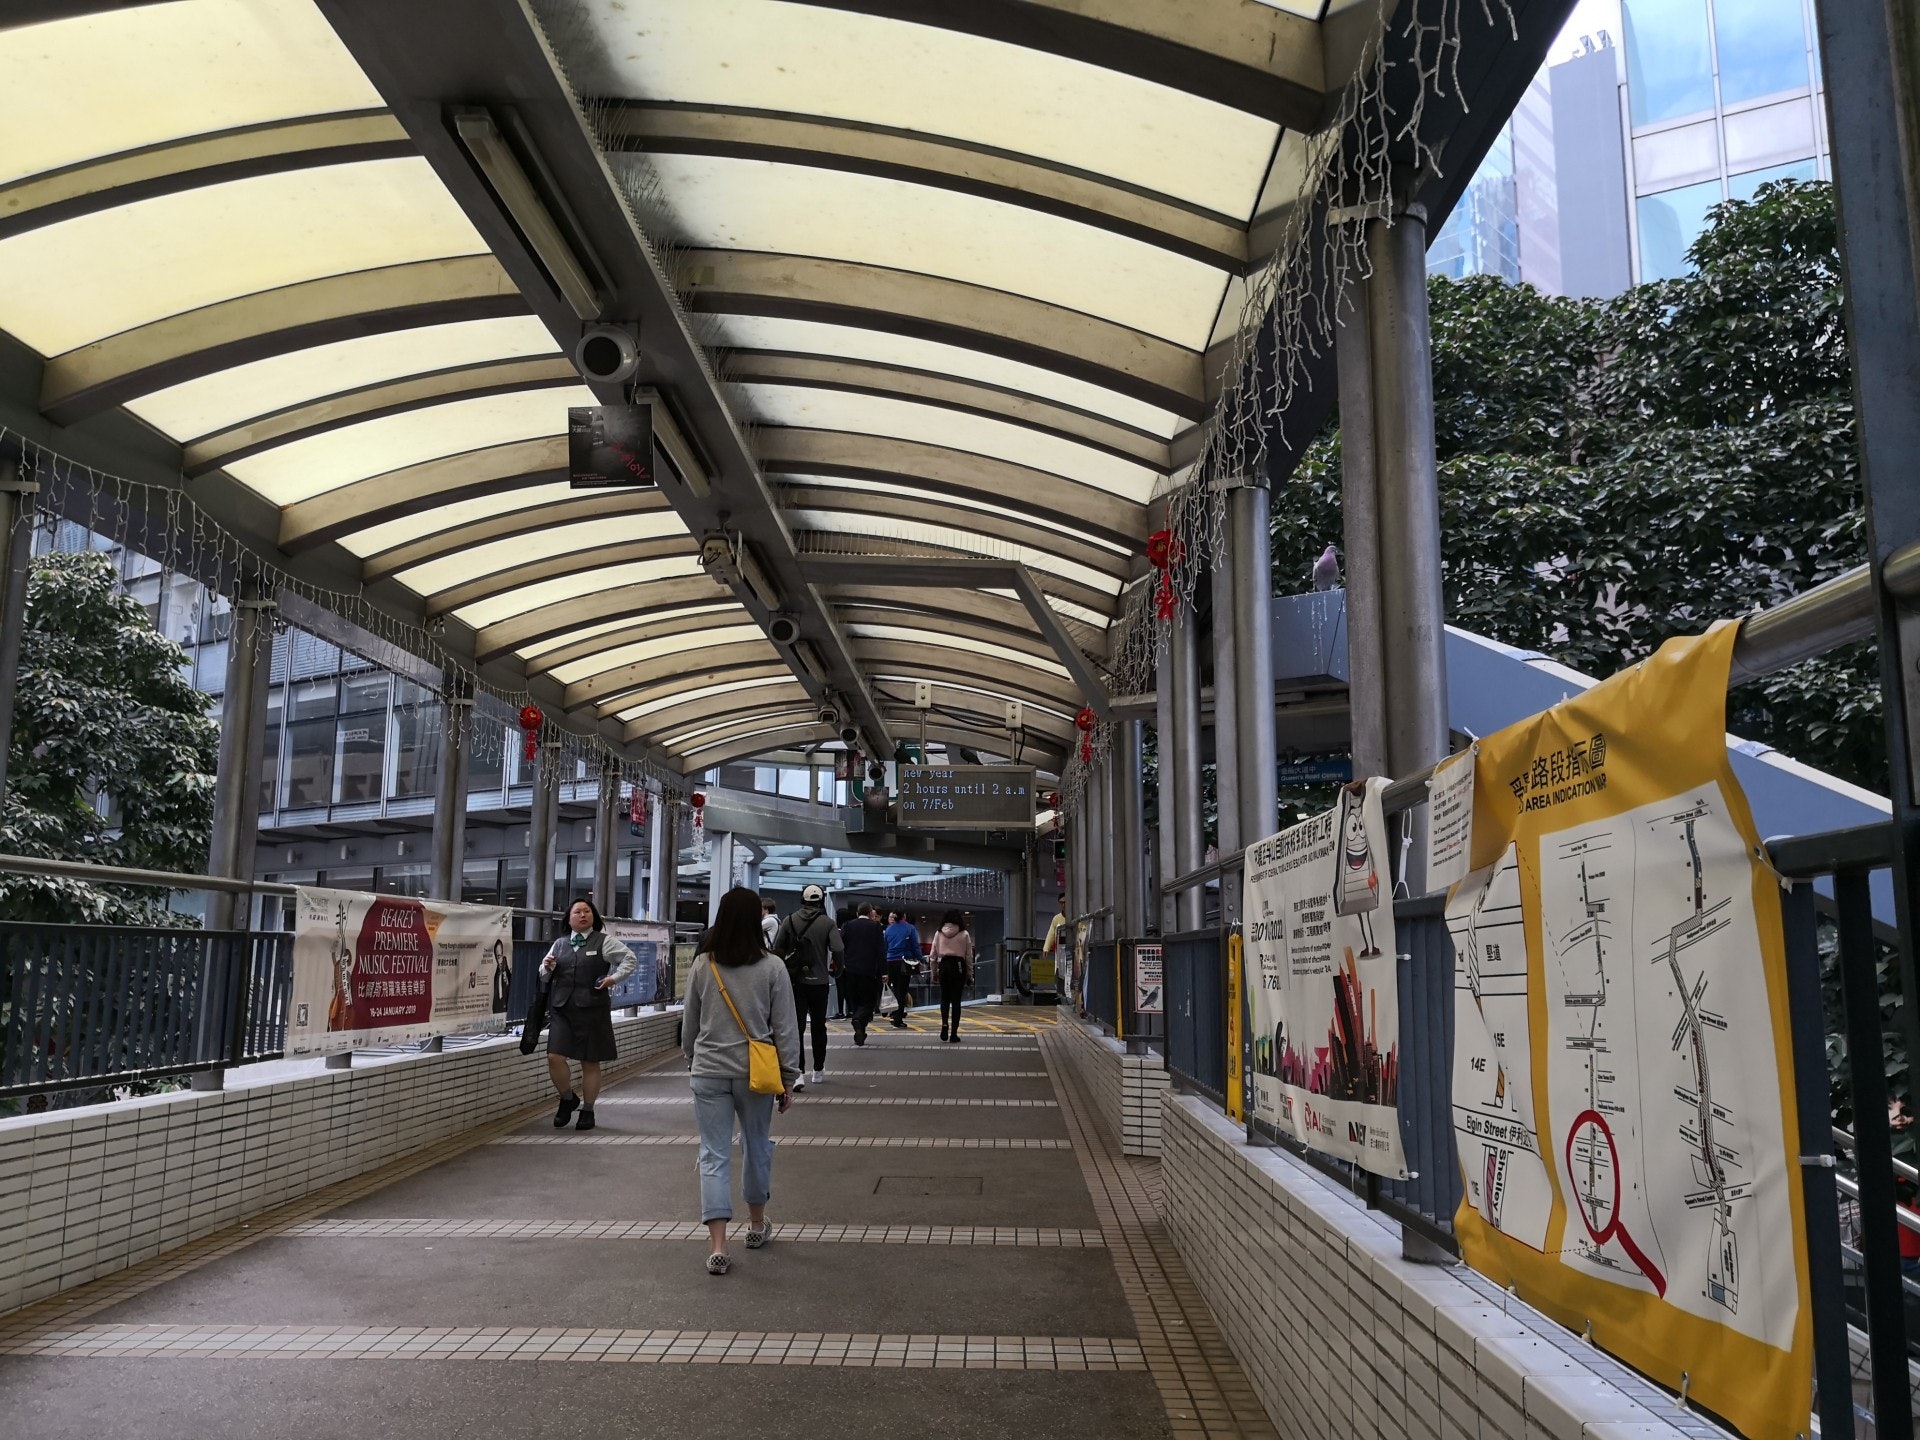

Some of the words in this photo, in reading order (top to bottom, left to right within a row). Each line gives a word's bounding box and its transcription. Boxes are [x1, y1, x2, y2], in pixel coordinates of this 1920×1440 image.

[928, 770, 955, 780] year
[903, 782, 910, 794] 2
[915, 782, 948, 794] hours
[954, 783, 985, 795] until
[992, 783, 999, 795] 2
[1005, 785, 1025, 795] a.m
[1525, 793, 1552, 812] AREA
[1552, 780, 1596, 805] INDICATION
[903, 802, 915, 810] on
[922, 798, 954, 811] 7/Feb
[380, 906, 416, 928] BEARE'S
[373, 931, 419, 951] PREMIERE
[358, 954, 390, 975] MUSIC
[391, 955, 429, 974] FESTIVAL
[383, 1005, 405, 1017] JANUARY
[405, 1004, 417, 1015] 2019
[1493, 1033, 1505, 1048] 15E
[1470, 1056, 1486, 1072] 14E
[1466, 1115, 1482, 1135] Elgin
[1483, 1121, 1507, 1139] Street
[1493, 1148, 1507, 1212] Shelley
